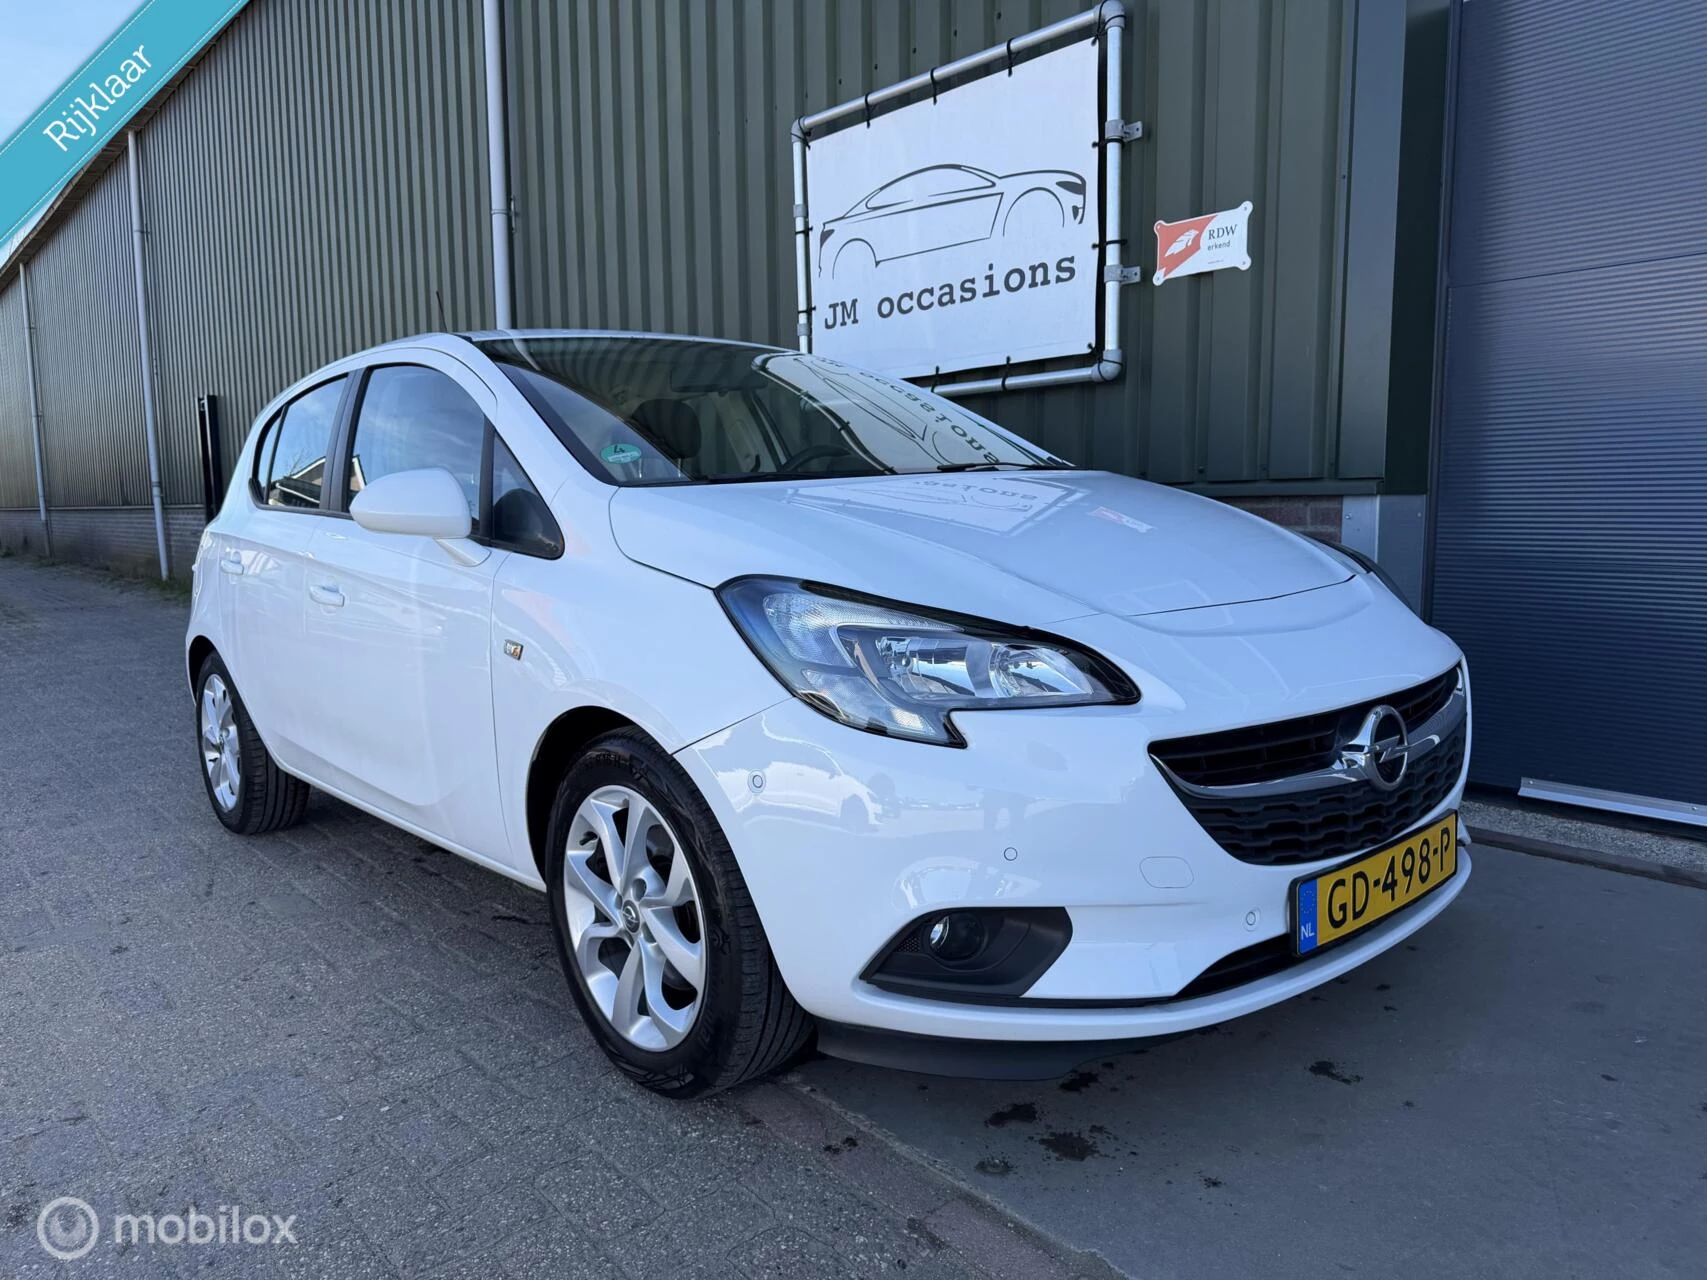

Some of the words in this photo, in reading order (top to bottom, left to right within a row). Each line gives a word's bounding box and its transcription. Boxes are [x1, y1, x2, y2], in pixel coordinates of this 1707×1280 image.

[1208, 224, 1238, 240] RDW
[824, 298, 859, 330] JM
[876, 255, 1076, 319] occasions
[1327, 826, 1451, 929] GD-498-P
[1300, 922, 1315, 941] NL
